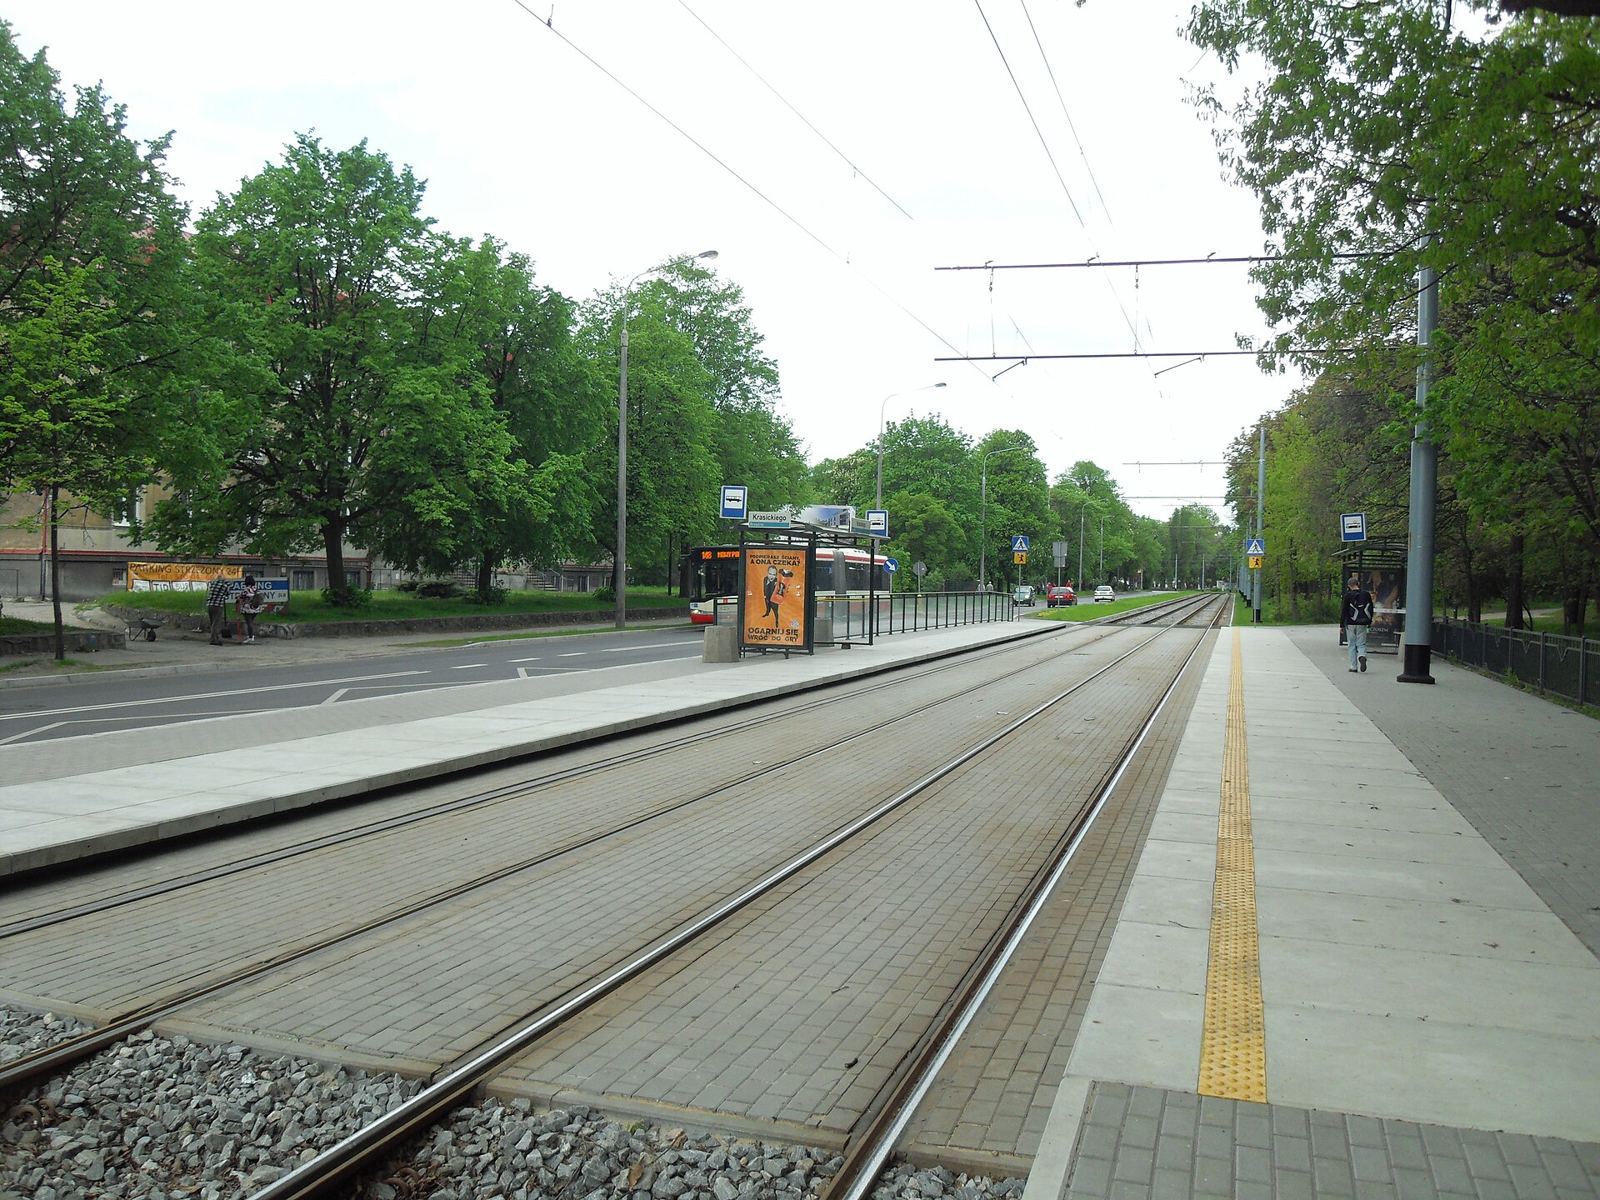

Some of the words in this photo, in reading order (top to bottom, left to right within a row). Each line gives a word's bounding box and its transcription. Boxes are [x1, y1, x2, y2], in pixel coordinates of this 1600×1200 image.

[752, 513, 787, 523] Krasickiego
[129, 563, 172, 574] PARKING
[748, 627, 785, 635] OGARNIJ
